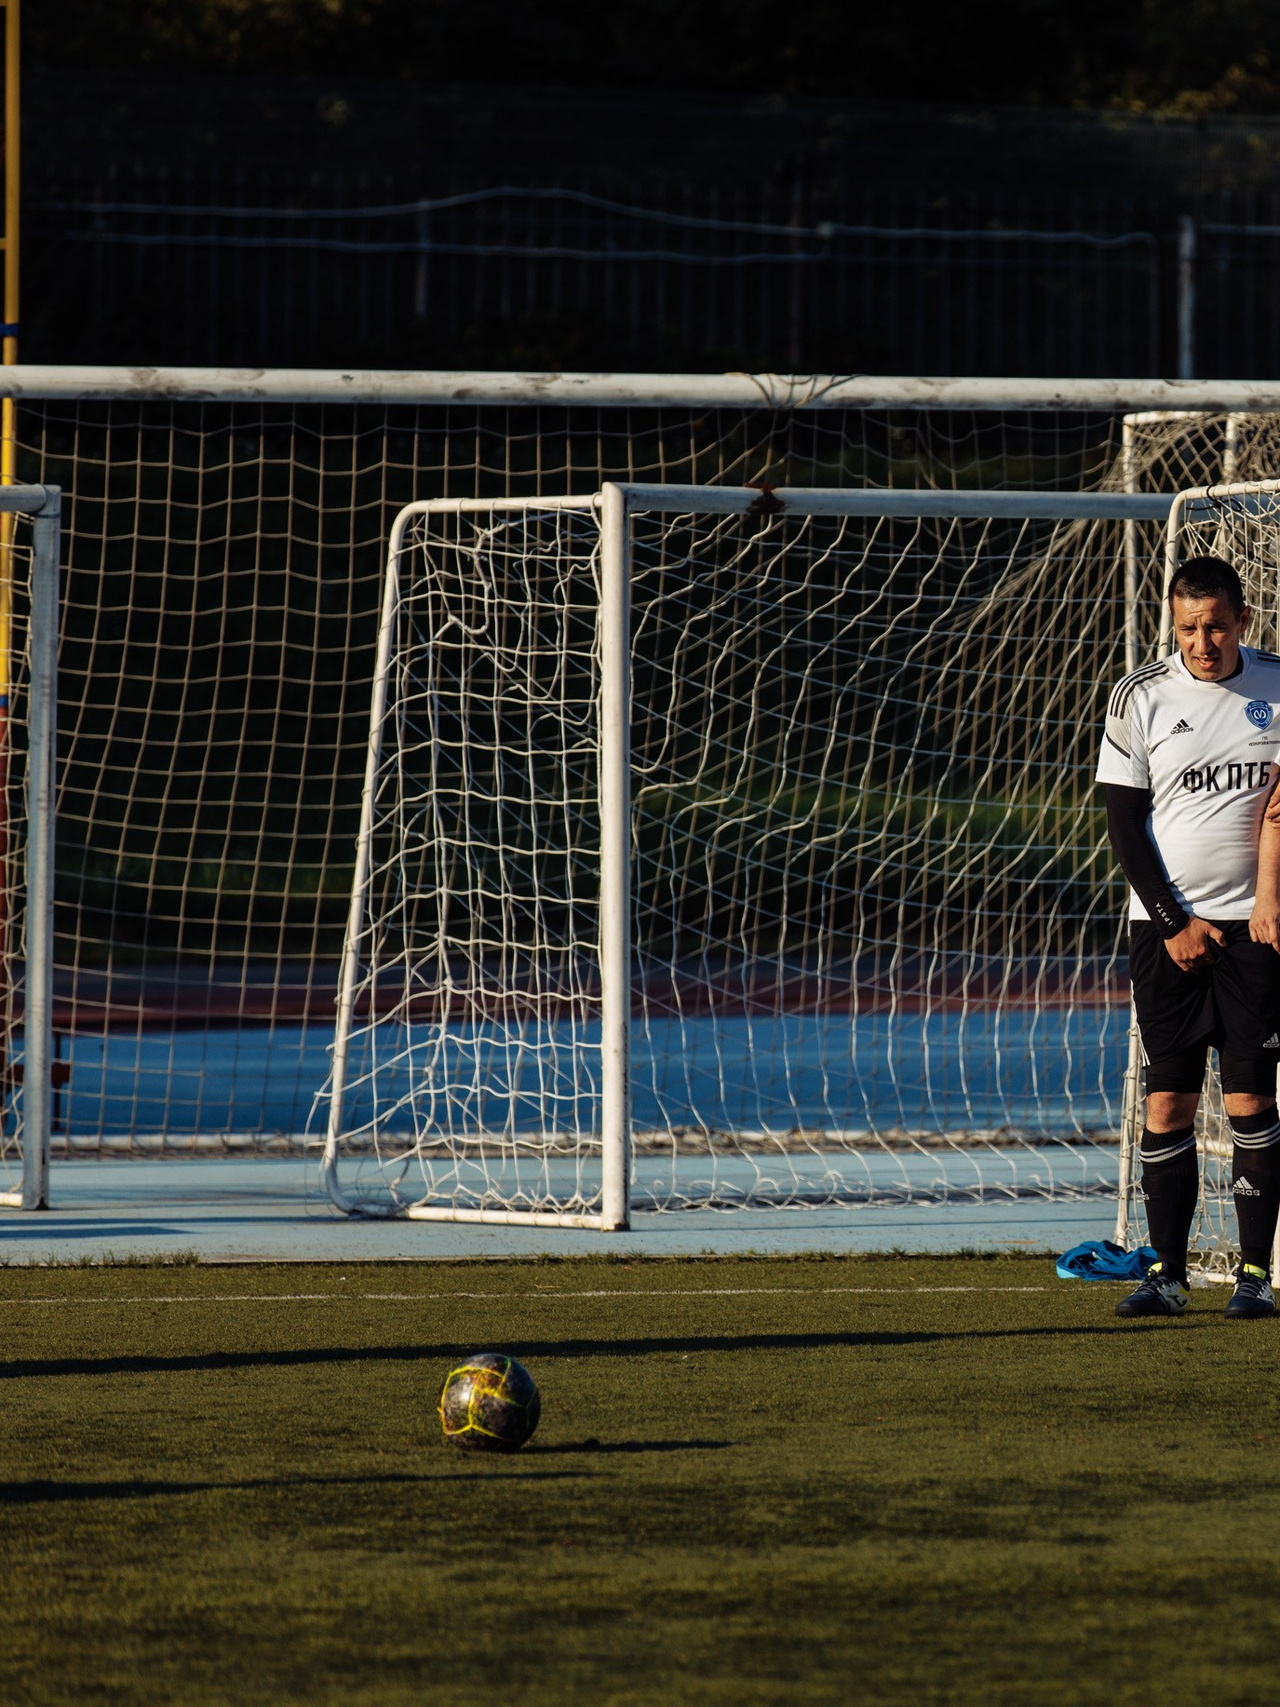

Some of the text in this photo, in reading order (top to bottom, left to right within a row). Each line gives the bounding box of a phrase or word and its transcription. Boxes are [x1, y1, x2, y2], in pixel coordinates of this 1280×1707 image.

[1183, 761, 1271, 793] ФК ПТБ
[1155, 902, 1175, 926] IPSTA
